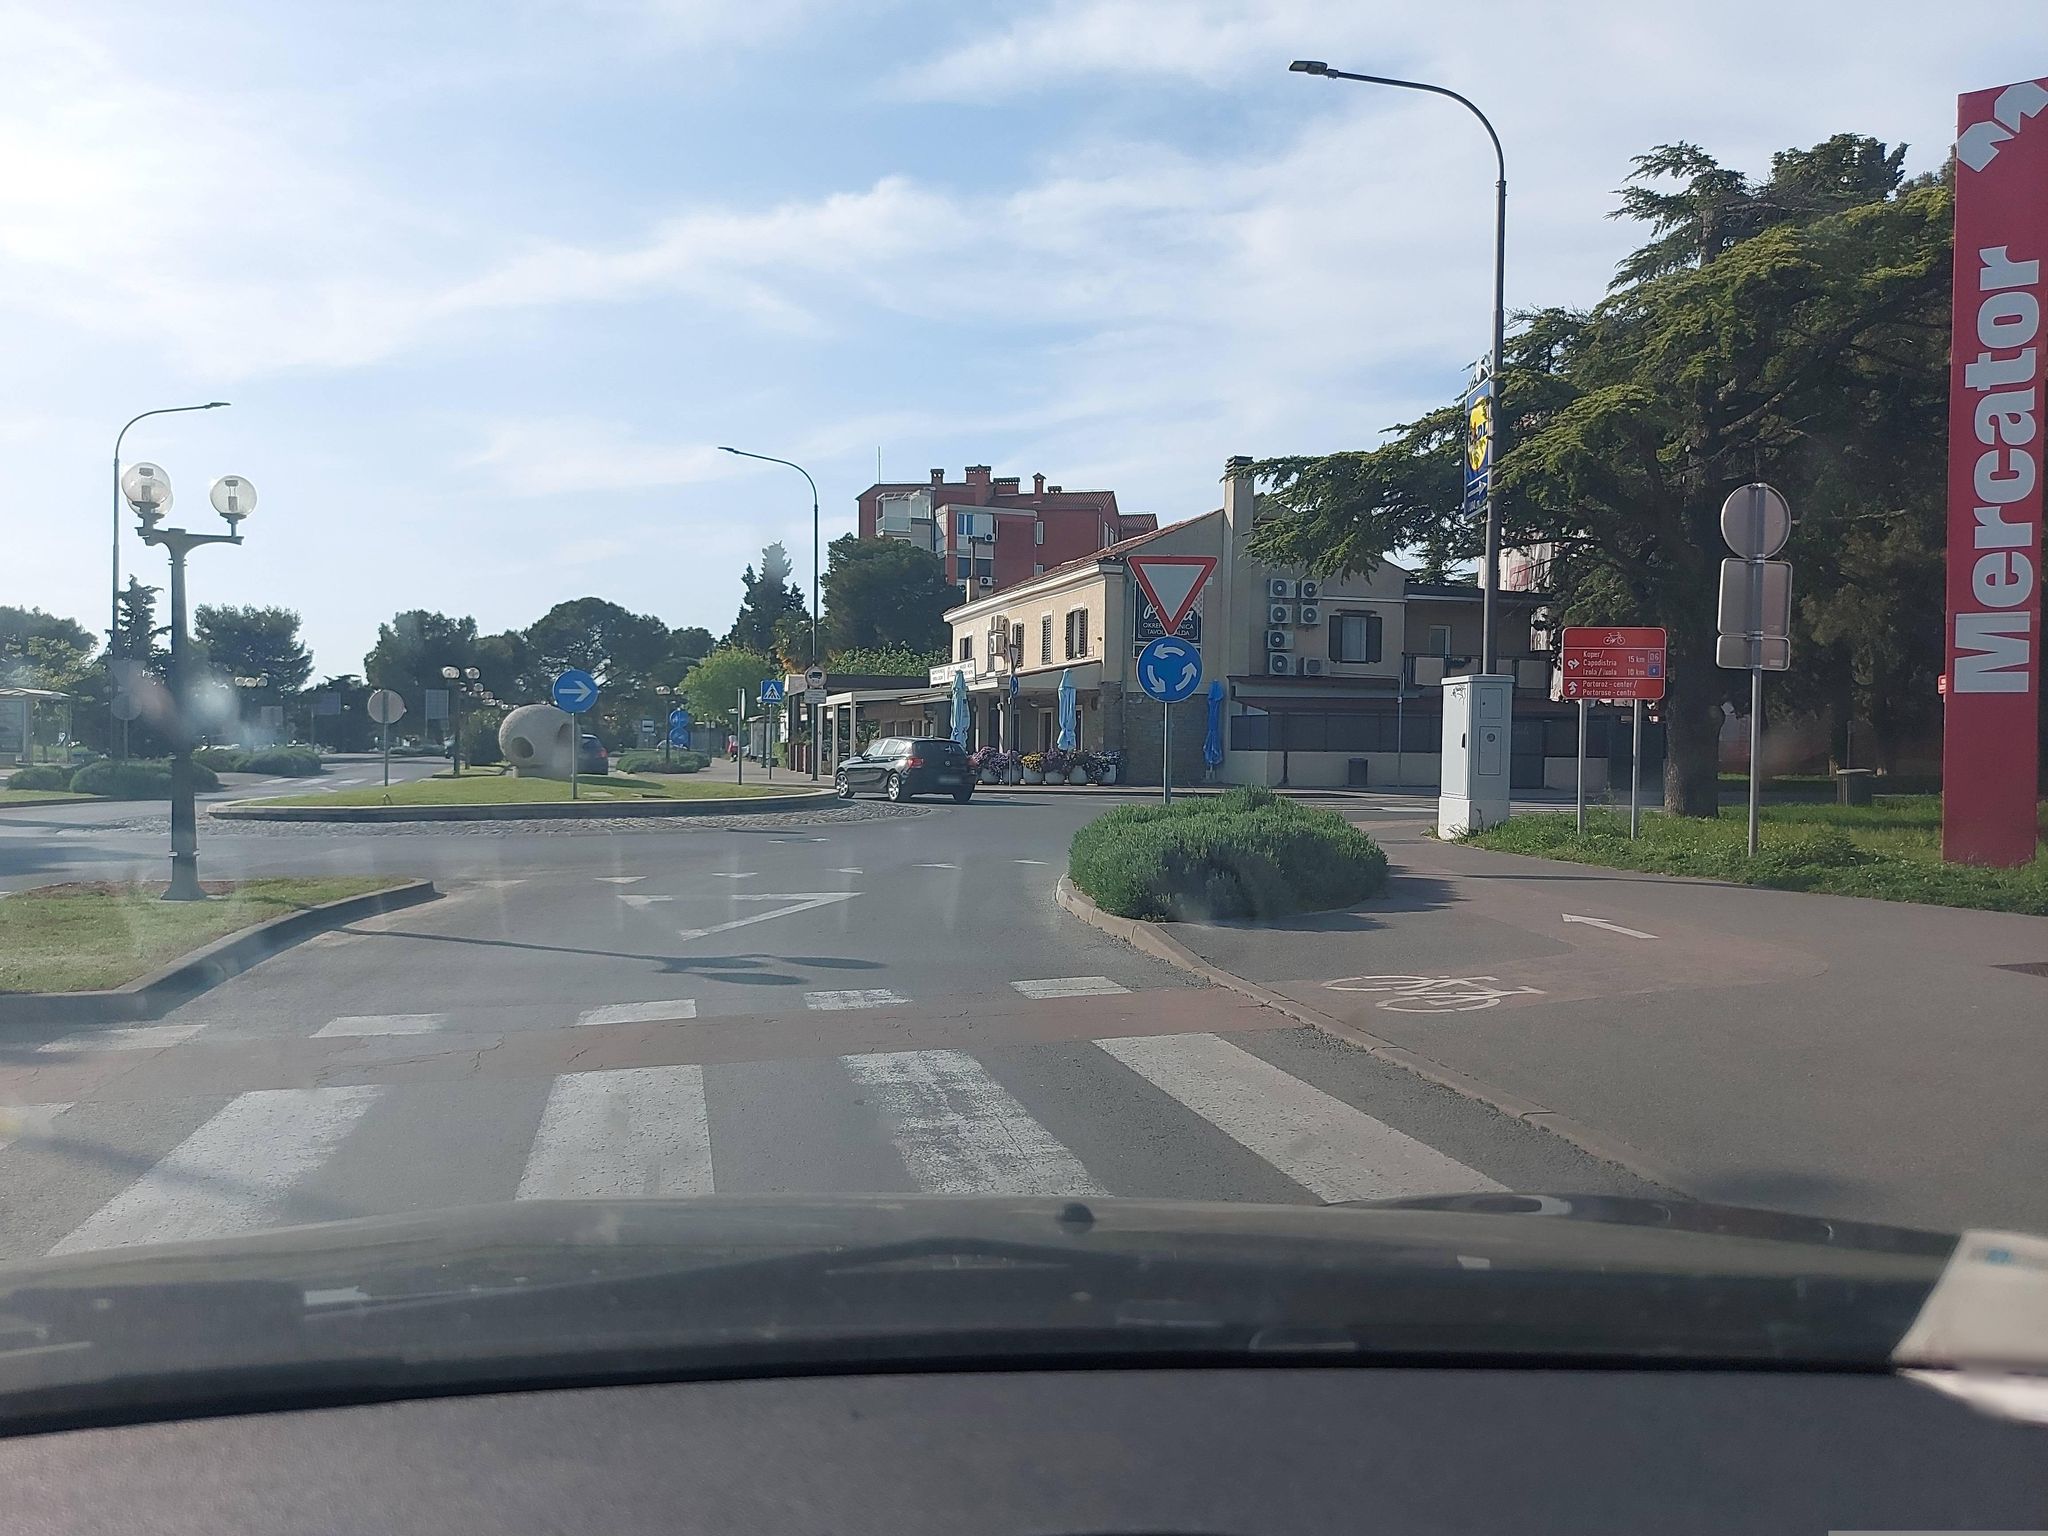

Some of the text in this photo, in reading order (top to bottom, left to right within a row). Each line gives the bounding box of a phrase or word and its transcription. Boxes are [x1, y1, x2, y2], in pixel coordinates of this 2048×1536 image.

[1954, 245, 2040, 693] Mercator
[1583, 659, 1617, 667] Capodistria
[1628, 655, 1635, 663] 15
[1636, 655, 1645, 663] km
[1628, 668, 1635, 676] 10
[1636, 668, 1645, 676] km
